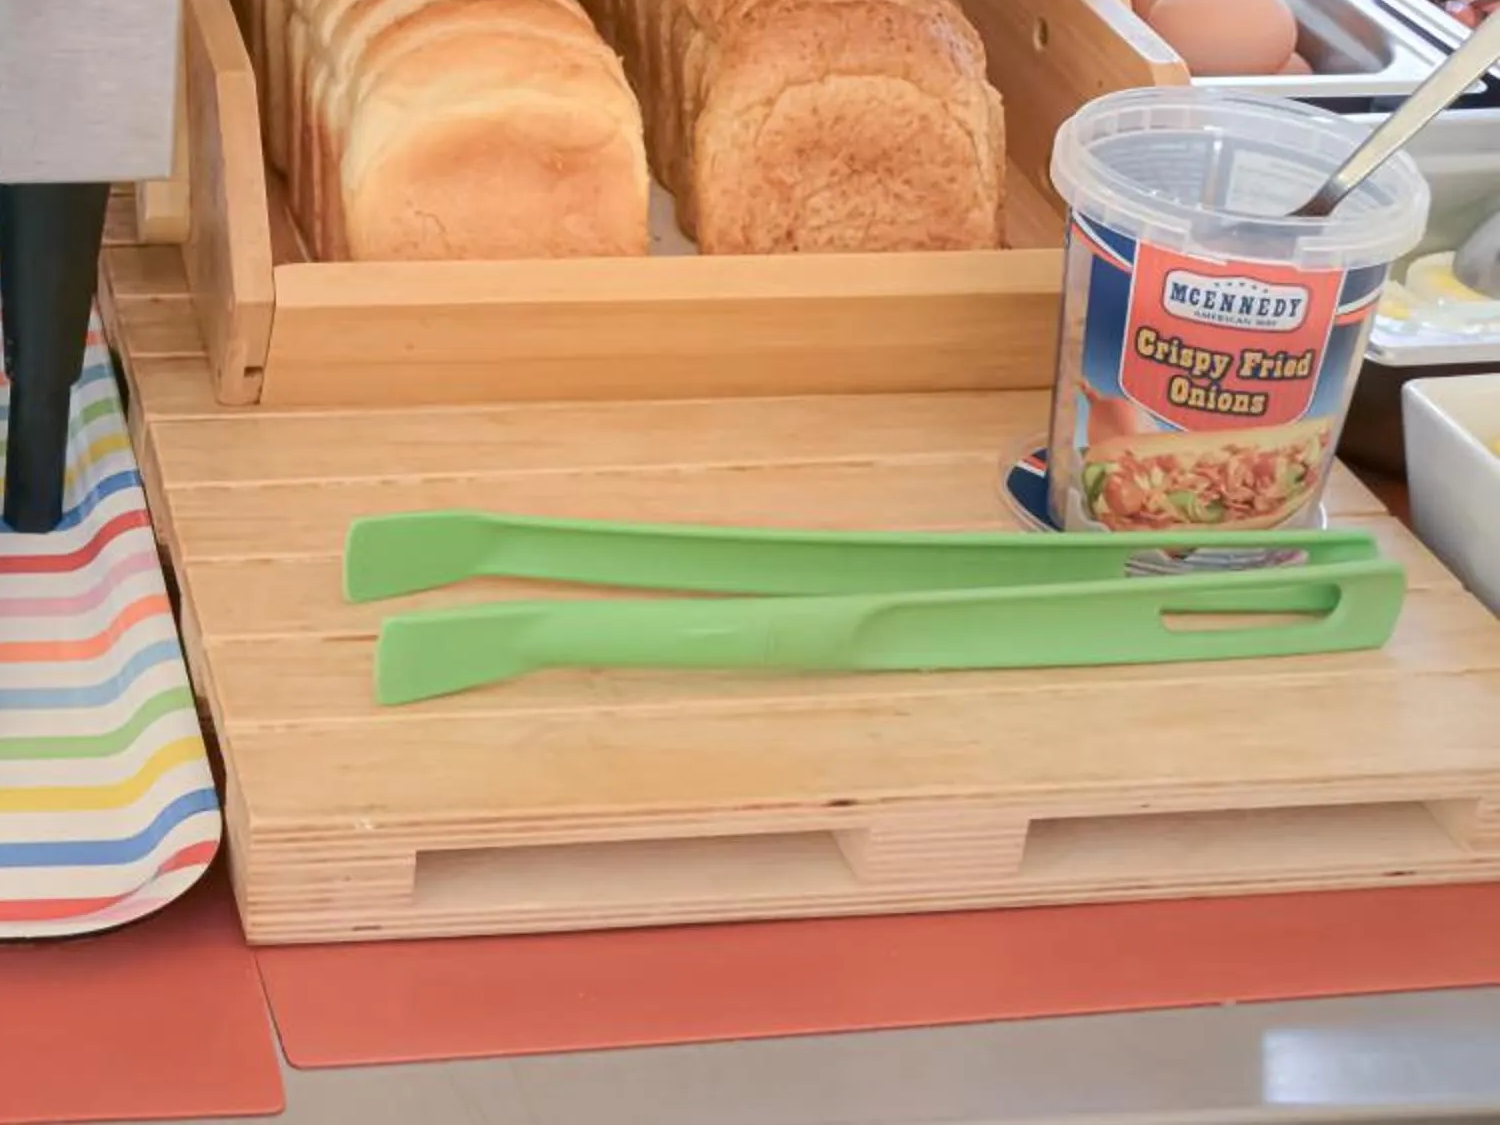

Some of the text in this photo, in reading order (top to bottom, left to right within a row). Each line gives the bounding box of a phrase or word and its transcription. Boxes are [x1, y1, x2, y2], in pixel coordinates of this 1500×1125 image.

[1169, 280, 1303, 318] MCENNEDY
[1193, 309, 1253, 326] AMERICAN
[1136, 327, 1314, 379] Crispy Fried
[1169, 376, 1267, 414] Onions
